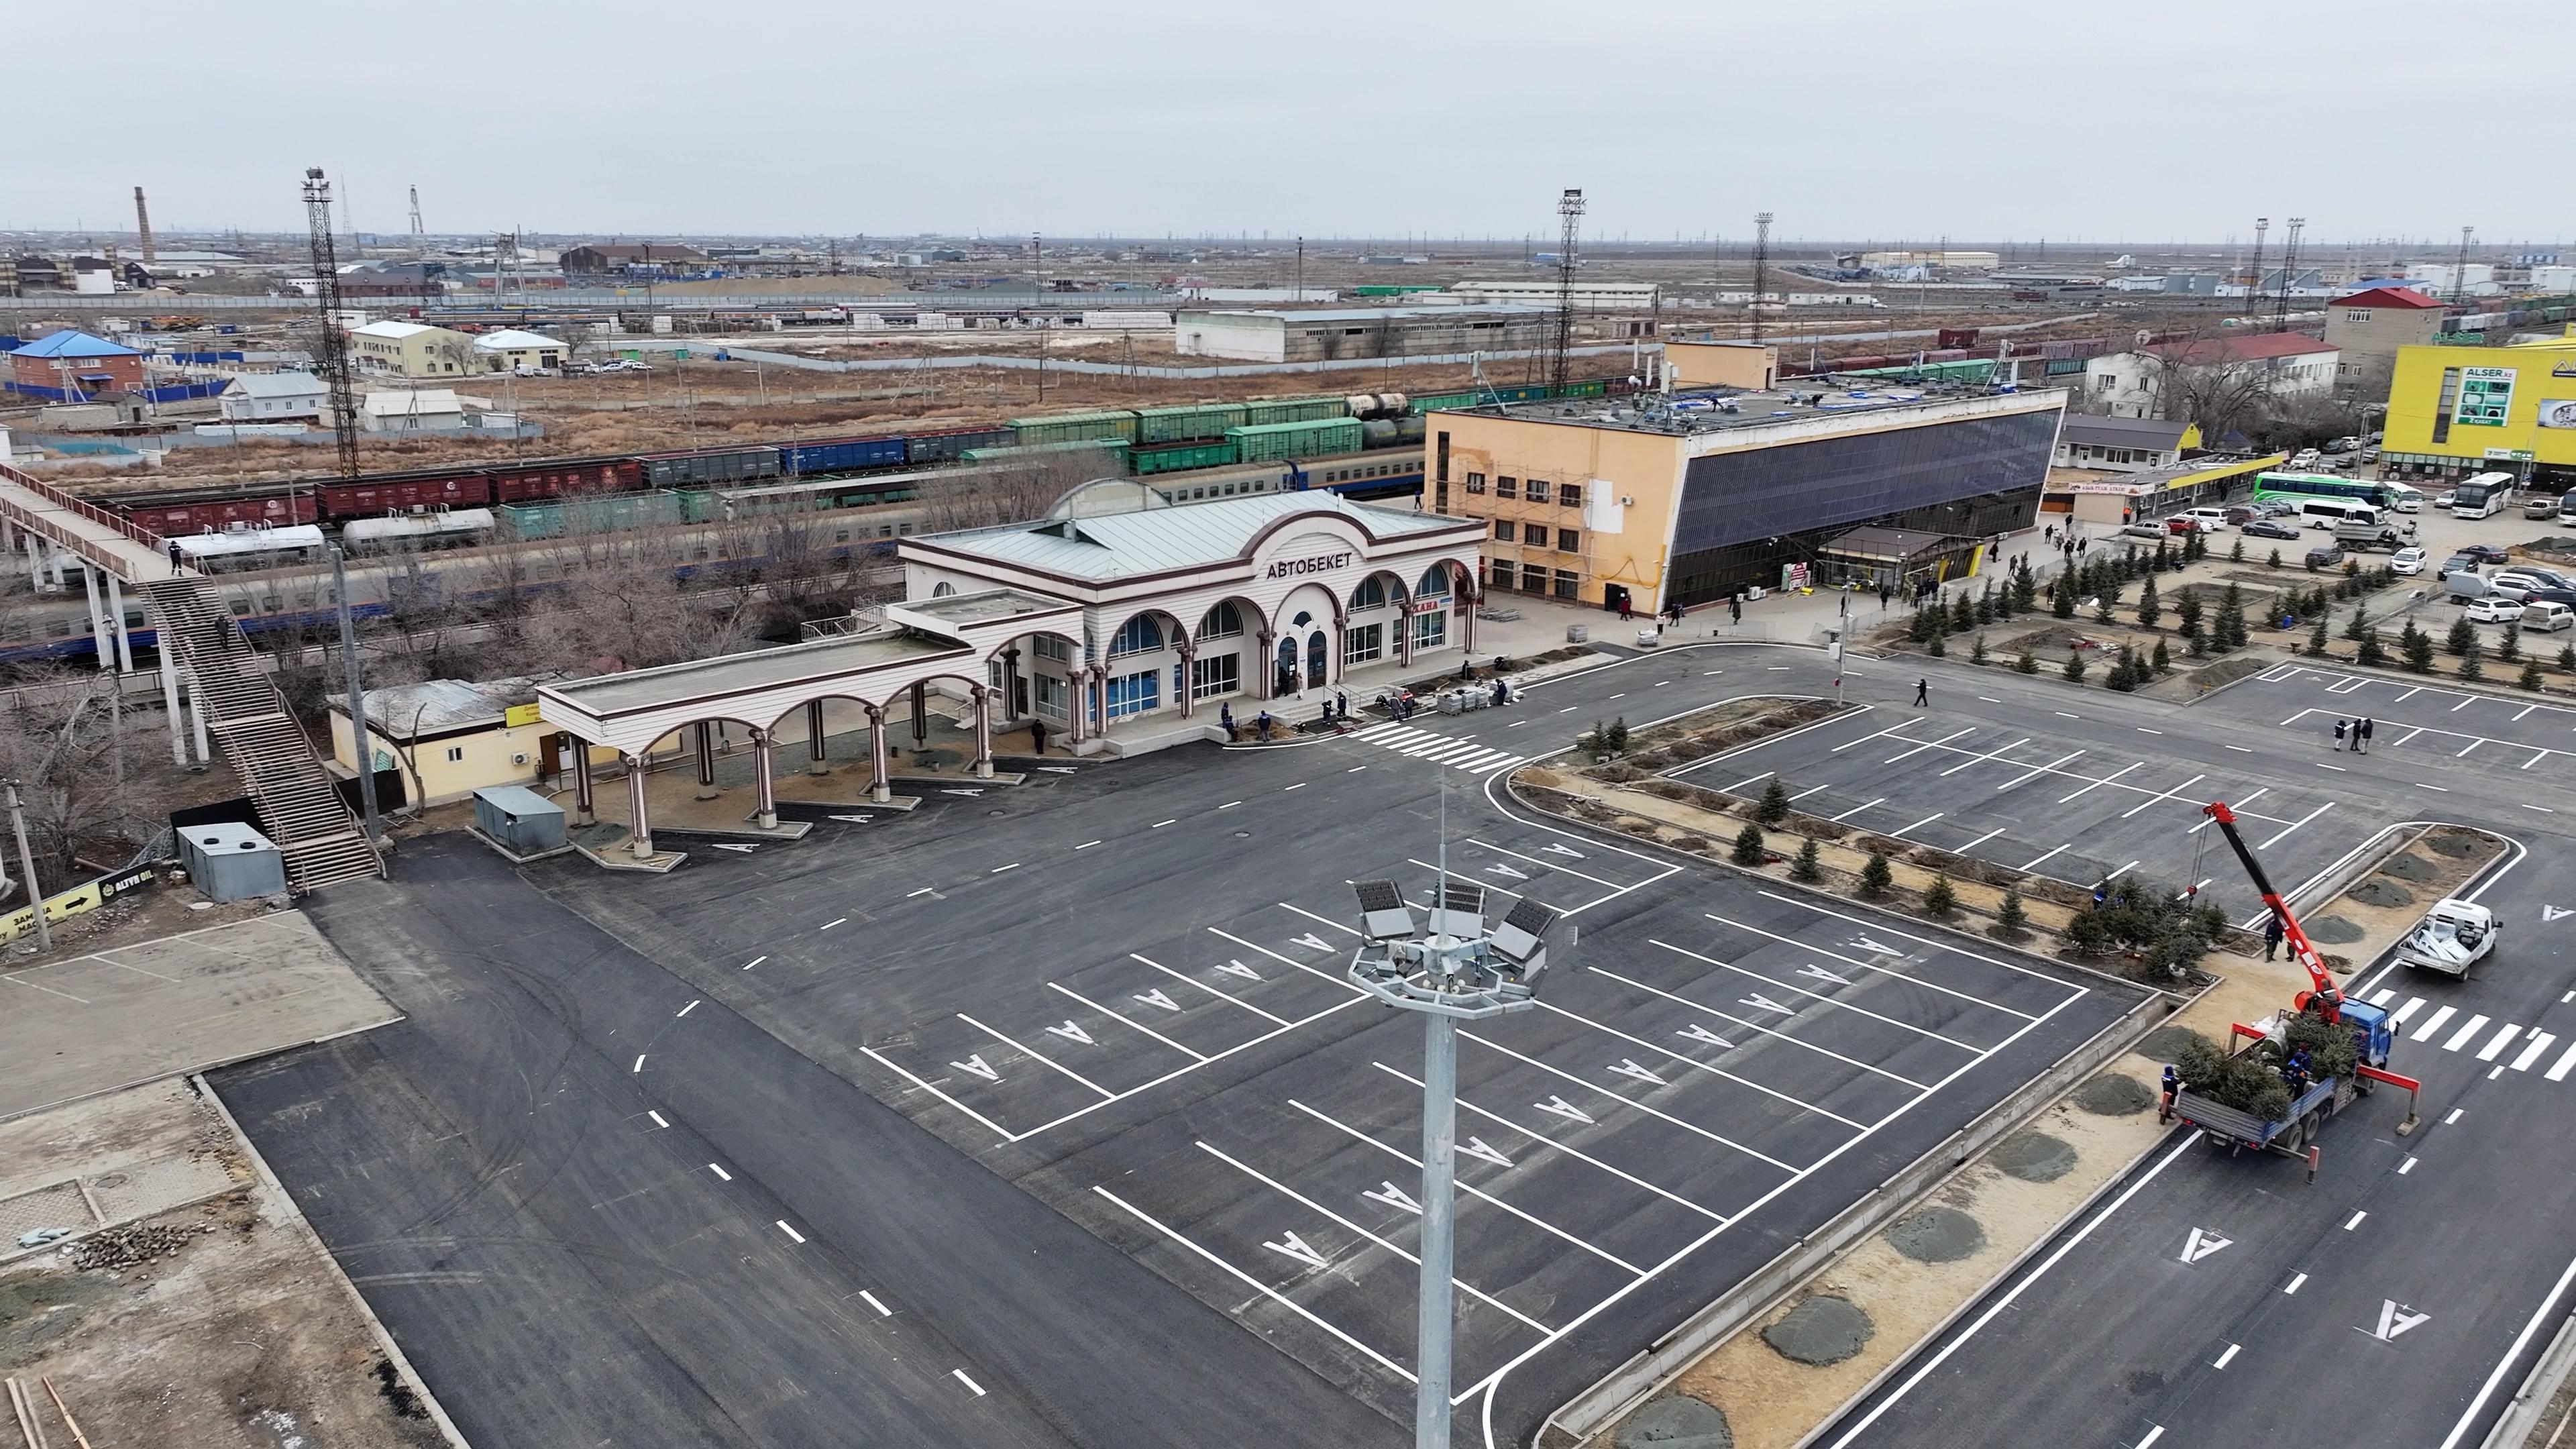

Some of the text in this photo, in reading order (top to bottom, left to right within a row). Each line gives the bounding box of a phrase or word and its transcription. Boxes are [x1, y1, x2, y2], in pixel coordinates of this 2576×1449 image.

[1267, 553, 1352, 579] АВТОБЕКЕТ
[140, 869, 154, 881] OIL
[13, 906, 52, 926] ЗАМА
[18, 916, 51, 933] МАСА
